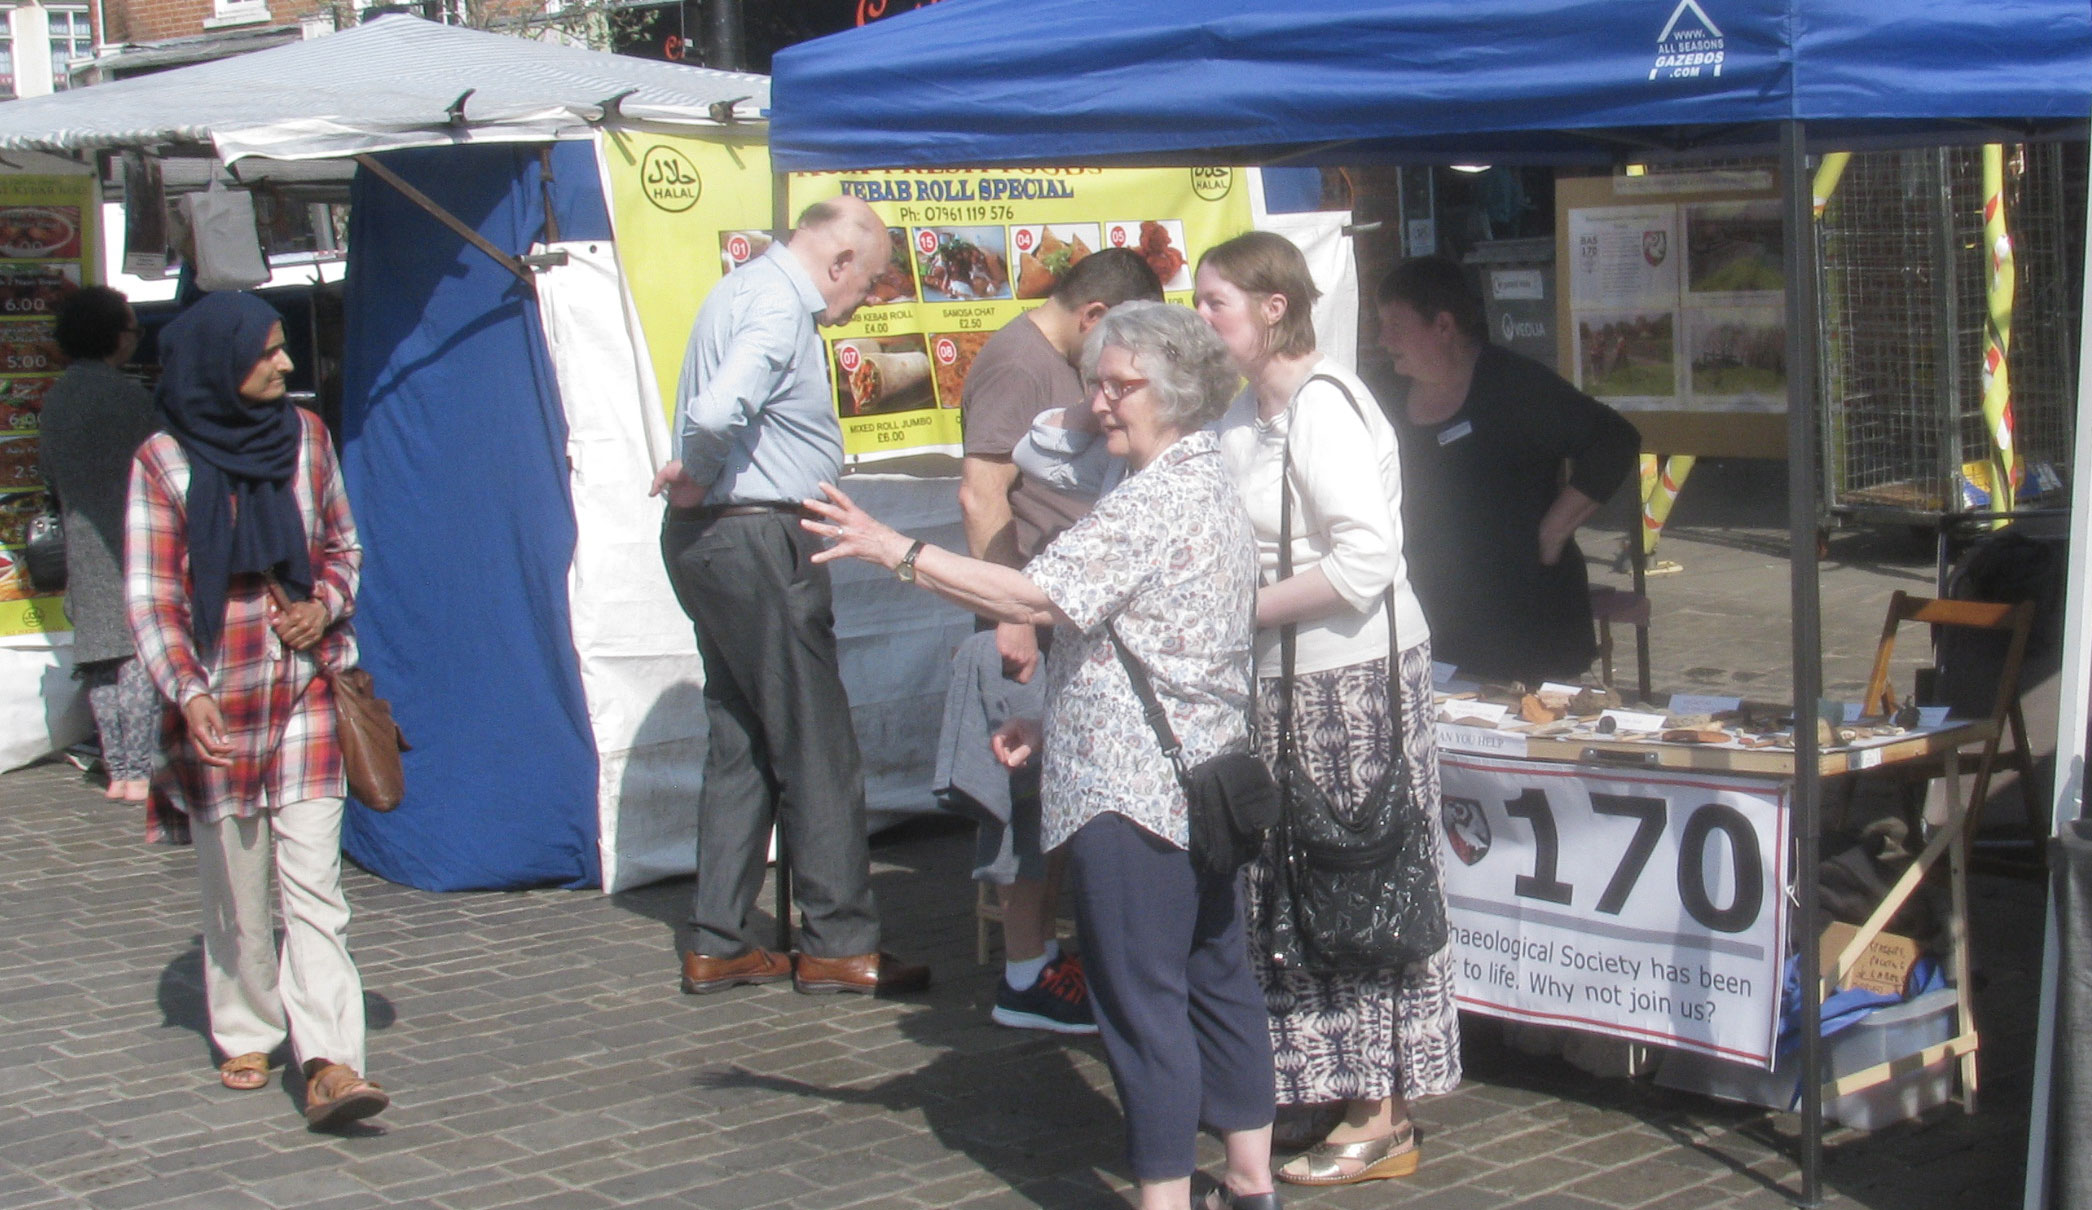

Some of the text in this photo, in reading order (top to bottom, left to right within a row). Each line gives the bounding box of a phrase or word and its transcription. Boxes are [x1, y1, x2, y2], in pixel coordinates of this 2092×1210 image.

[1658, 39, 1724, 55] ALL SEASONS
[1655, 51, 1724, 68] GAZEBOS
[1668, 67, 1700, 78] .COM
[648, 159, 696, 184] حلال
[840, 178, 1074, 202] KEBAB ROLL SPECIAL
[1196, 179, 1228, 190] HALAL
[653, 188, 695, 199] HALAL
[900, 205, 1014, 222] Ph: 07961 119 576
[920, 236, 933, 248] 15
[1017, 234, 1031, 246] 04
[1111, 231, 1125, 242] 05
[732, 242, 746, 256] 01
[5, 297, 45, 311] 6.00
[863, 311, 888, 321] KEBAB
[889, 309, 913, 320] ROLL
[943, 307, 995, 318] SAMOSA CHAT
[865, 322, 889, 334] £4.00
[959, 318, 982, 329] £2.50
[844, 352, 857, 364] 07
[941, 345, 953, 358] 08
[850, 416, 932, 433] MIXED ROLL JUMBO
[877, 431, 905, 443] £6.00
[1455, 732, 1475, 746] YOU
[1478, 735, 1504, 748] HELP
[1503, 788, 1764, 934] 170
[1560, 945, 1641, 981] Society
[1651, 957, 1691, 985] has
[1699, 965, 1752, 998] been
[1463, 958, 1482, 980] to
[1489, 961, 1520, 991] life.
[1529, 971, 1575, 1003] Why
[1585, 983, 1622, 1007] not
[1629, 987, 1671, 1014] join
[1681, 1001, 1717, 1024] us?
